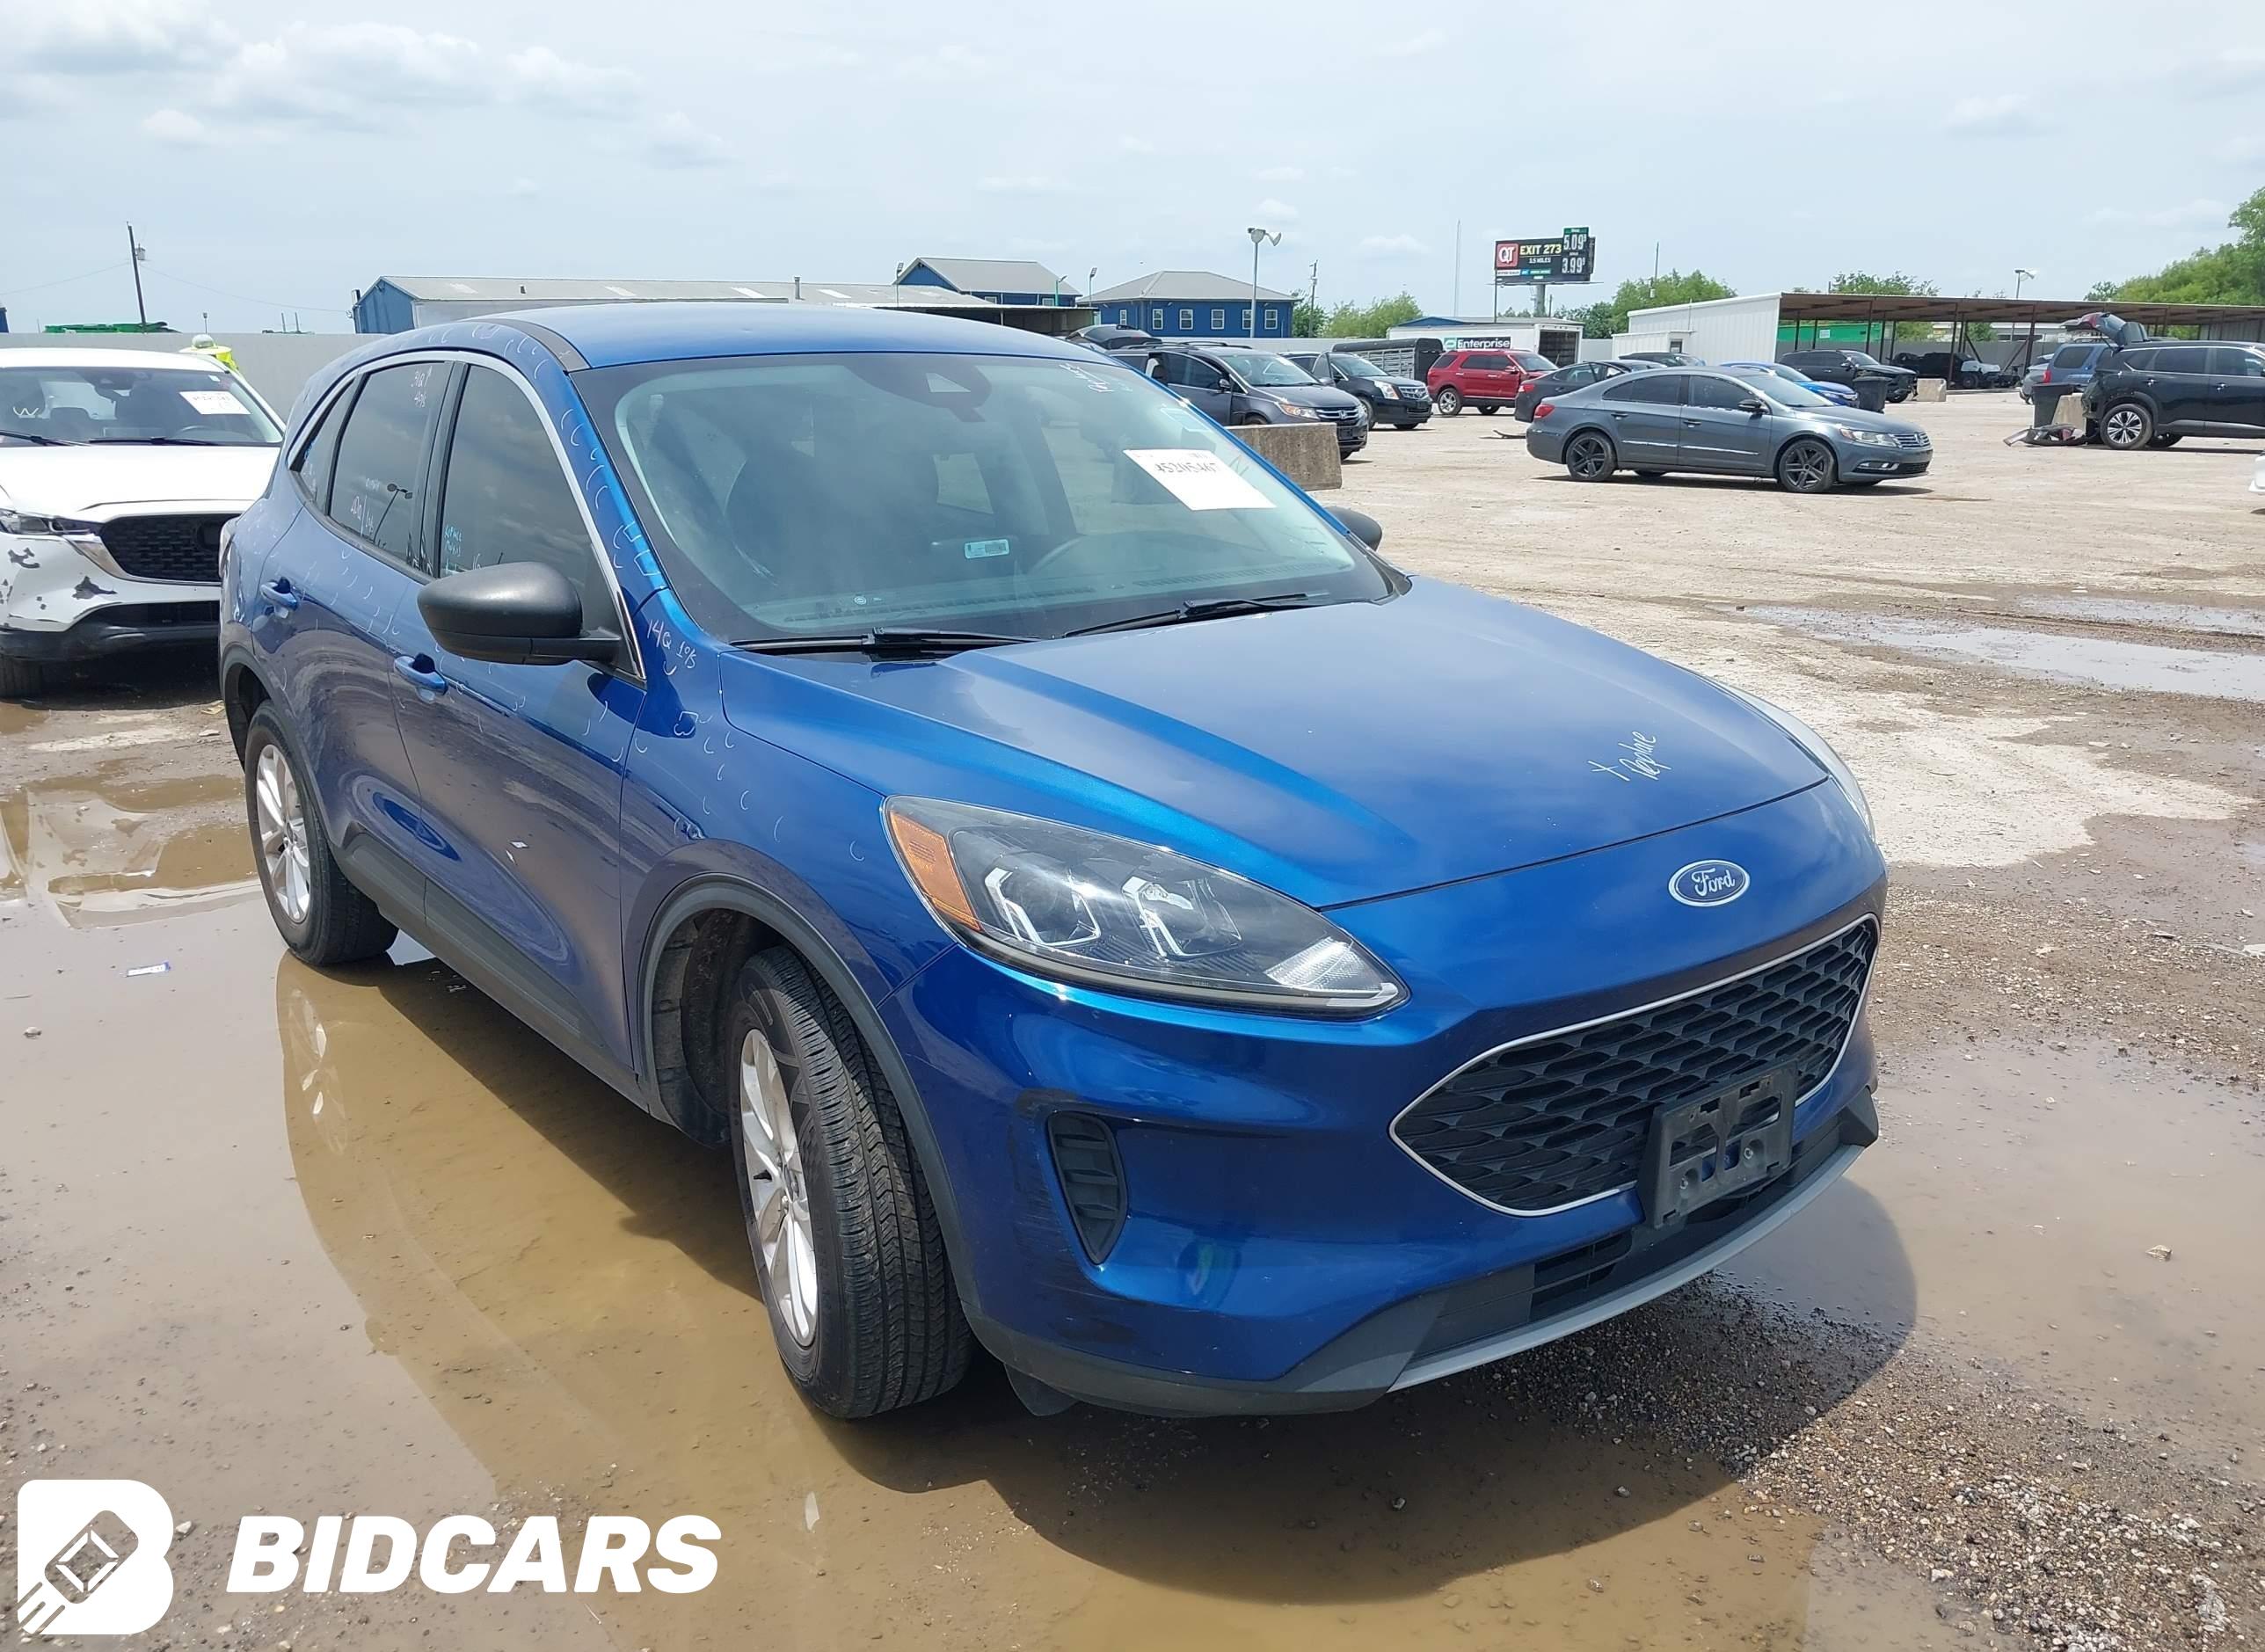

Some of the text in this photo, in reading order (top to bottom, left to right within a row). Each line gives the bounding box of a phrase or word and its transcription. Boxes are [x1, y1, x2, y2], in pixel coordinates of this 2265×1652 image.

[1498, 246, 1515, 264] QT
[1519, 244, 1541, 255] EXIT
[1543, 244, 1562, 254] 273
[1457, 338, 1510, 349] Enterprise
[1692, 868, 1735, 897] Ford
